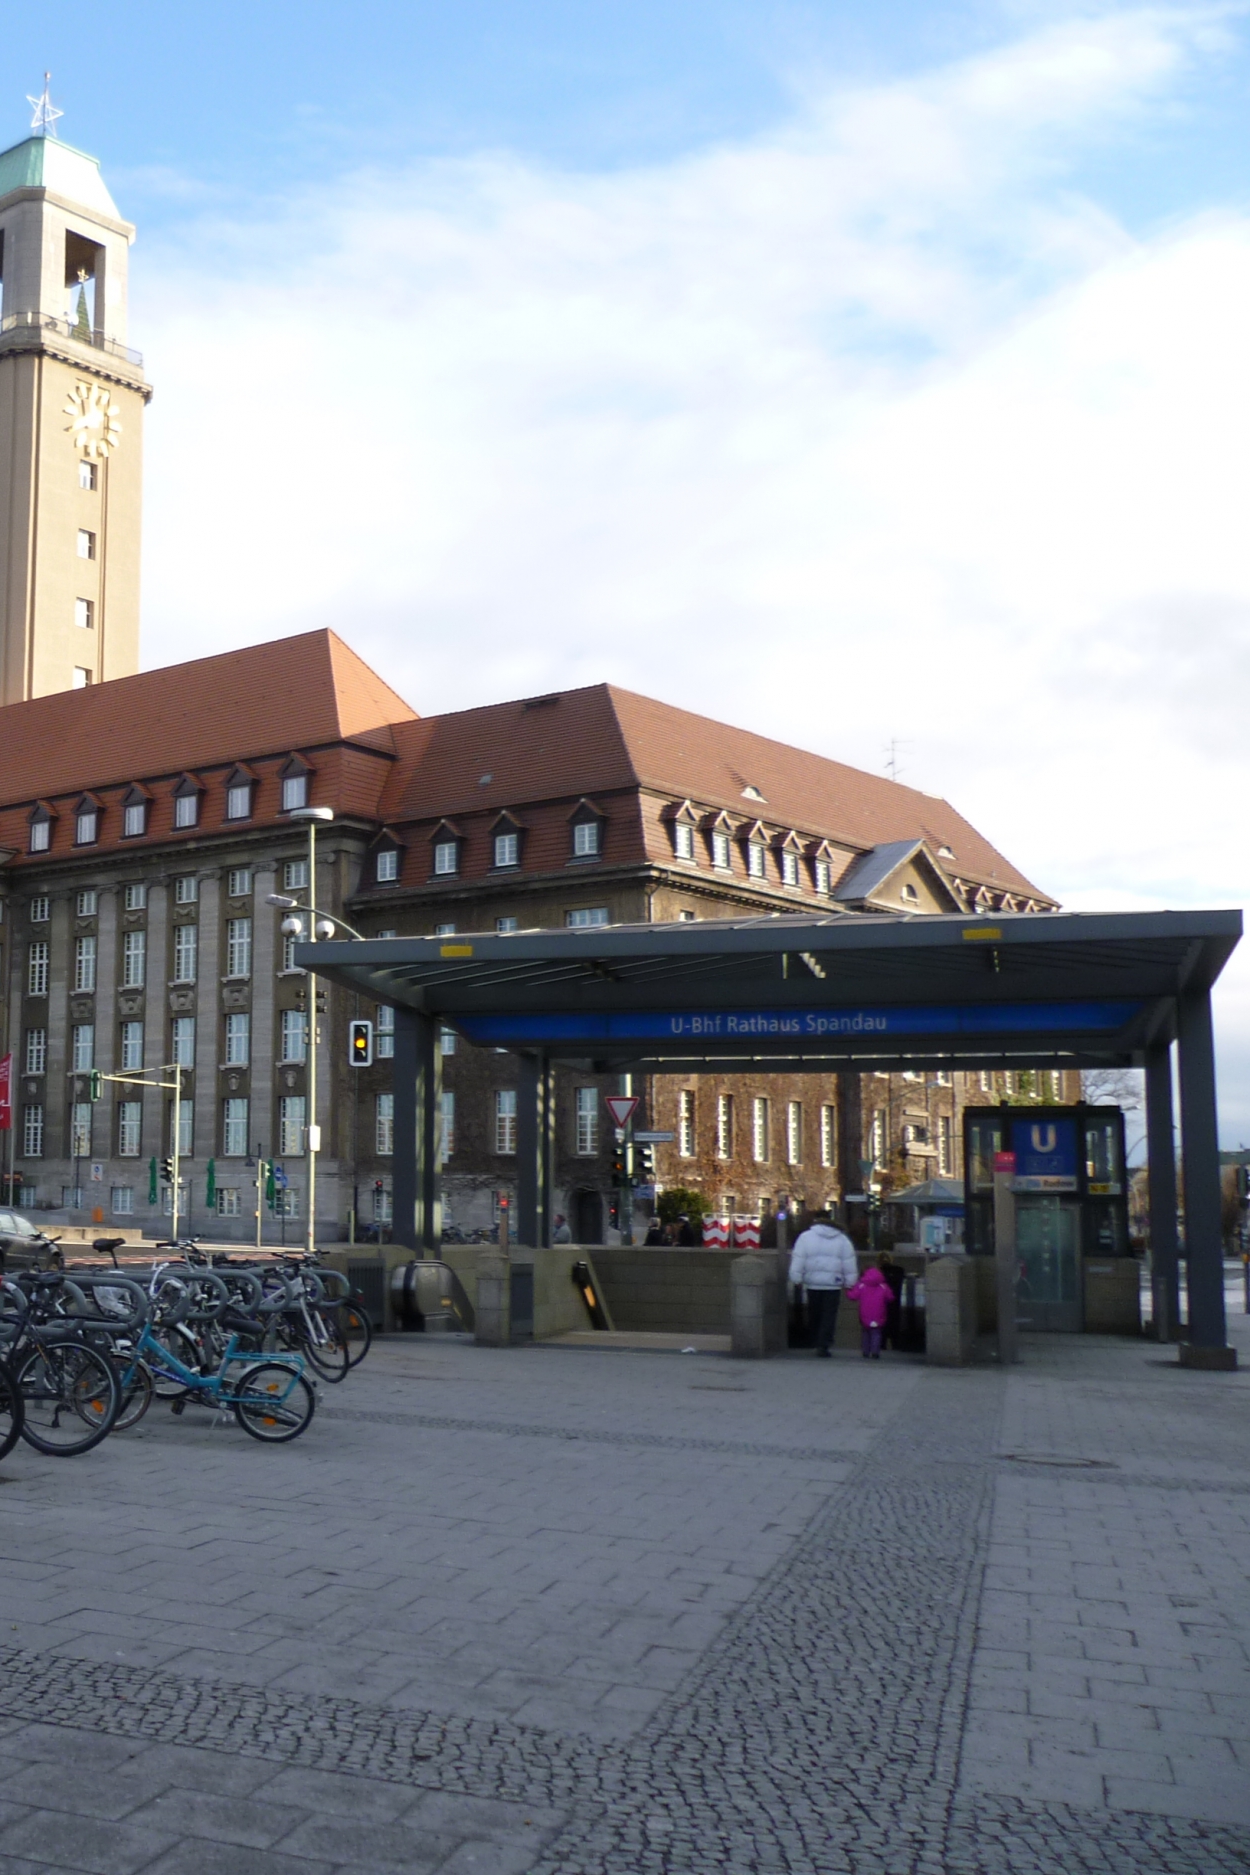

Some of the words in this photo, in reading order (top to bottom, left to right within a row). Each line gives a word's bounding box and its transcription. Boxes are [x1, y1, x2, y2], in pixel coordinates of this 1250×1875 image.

[671, 1015, 722, 1034] U-Bhf
[727, 1014, 800, 1033] Rathaus
[806, 1012, 887, 1035] Spandau
[1031, 1124, 1056, 1153] U
